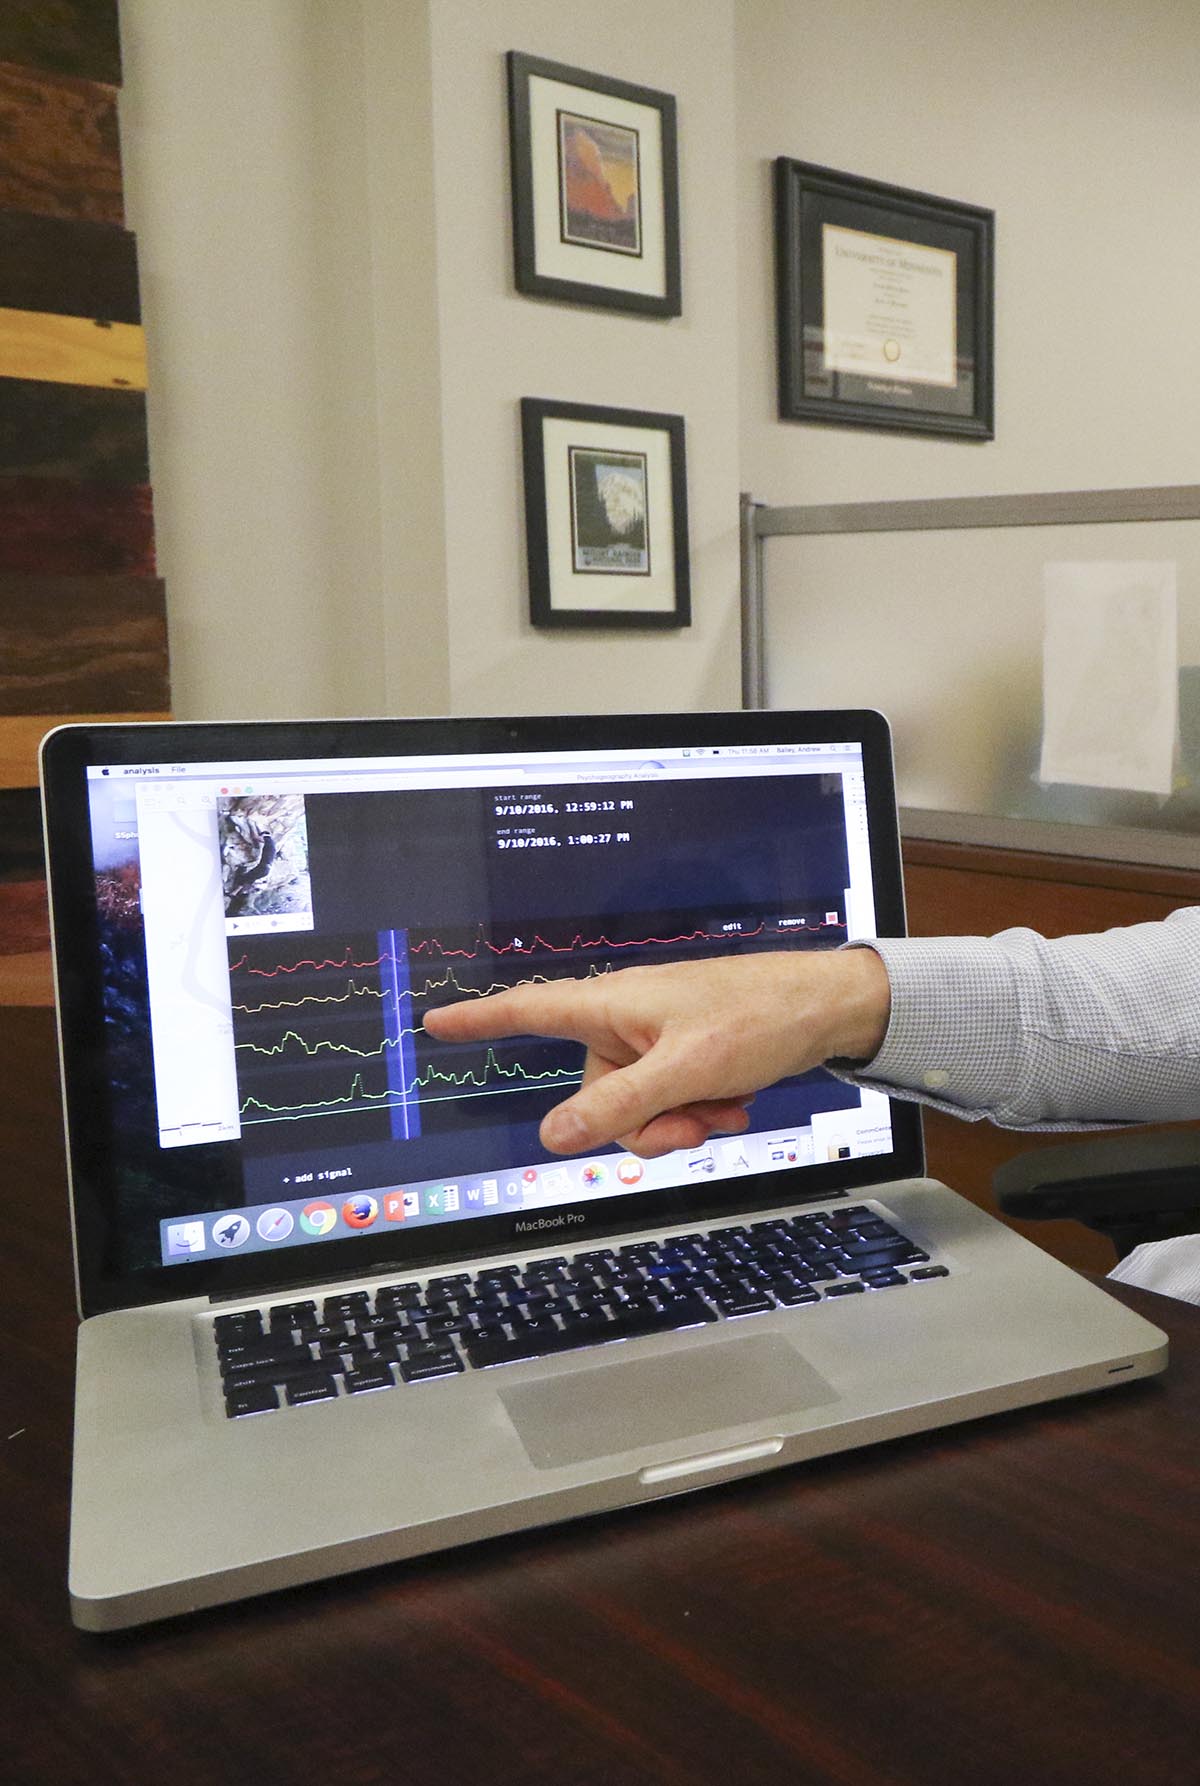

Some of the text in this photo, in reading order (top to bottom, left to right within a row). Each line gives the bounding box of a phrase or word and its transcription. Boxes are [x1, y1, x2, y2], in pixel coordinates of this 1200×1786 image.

[123, 767, 160, 775] analysis
[565, 801, 615, 812] 12:59:12
[620, 800, 634, 809] PM
[567, 833, 611, 845] 1:00:27
[616, 833, 630, 842] PM
[722, 922, 743, 931] edit
[778, 918, 806, 926] remove
[295, 1173, 313, 1183] add
[318, 1167, 353, 1180] signal
[466, 1188, 480, 1201] W
[389, 1200, 399, 1214] P
[429, 1194, 440, 1208] X
[515, 1213, 586, 1233] MacBook Pro
[371, 1317, 385, 1325] W
